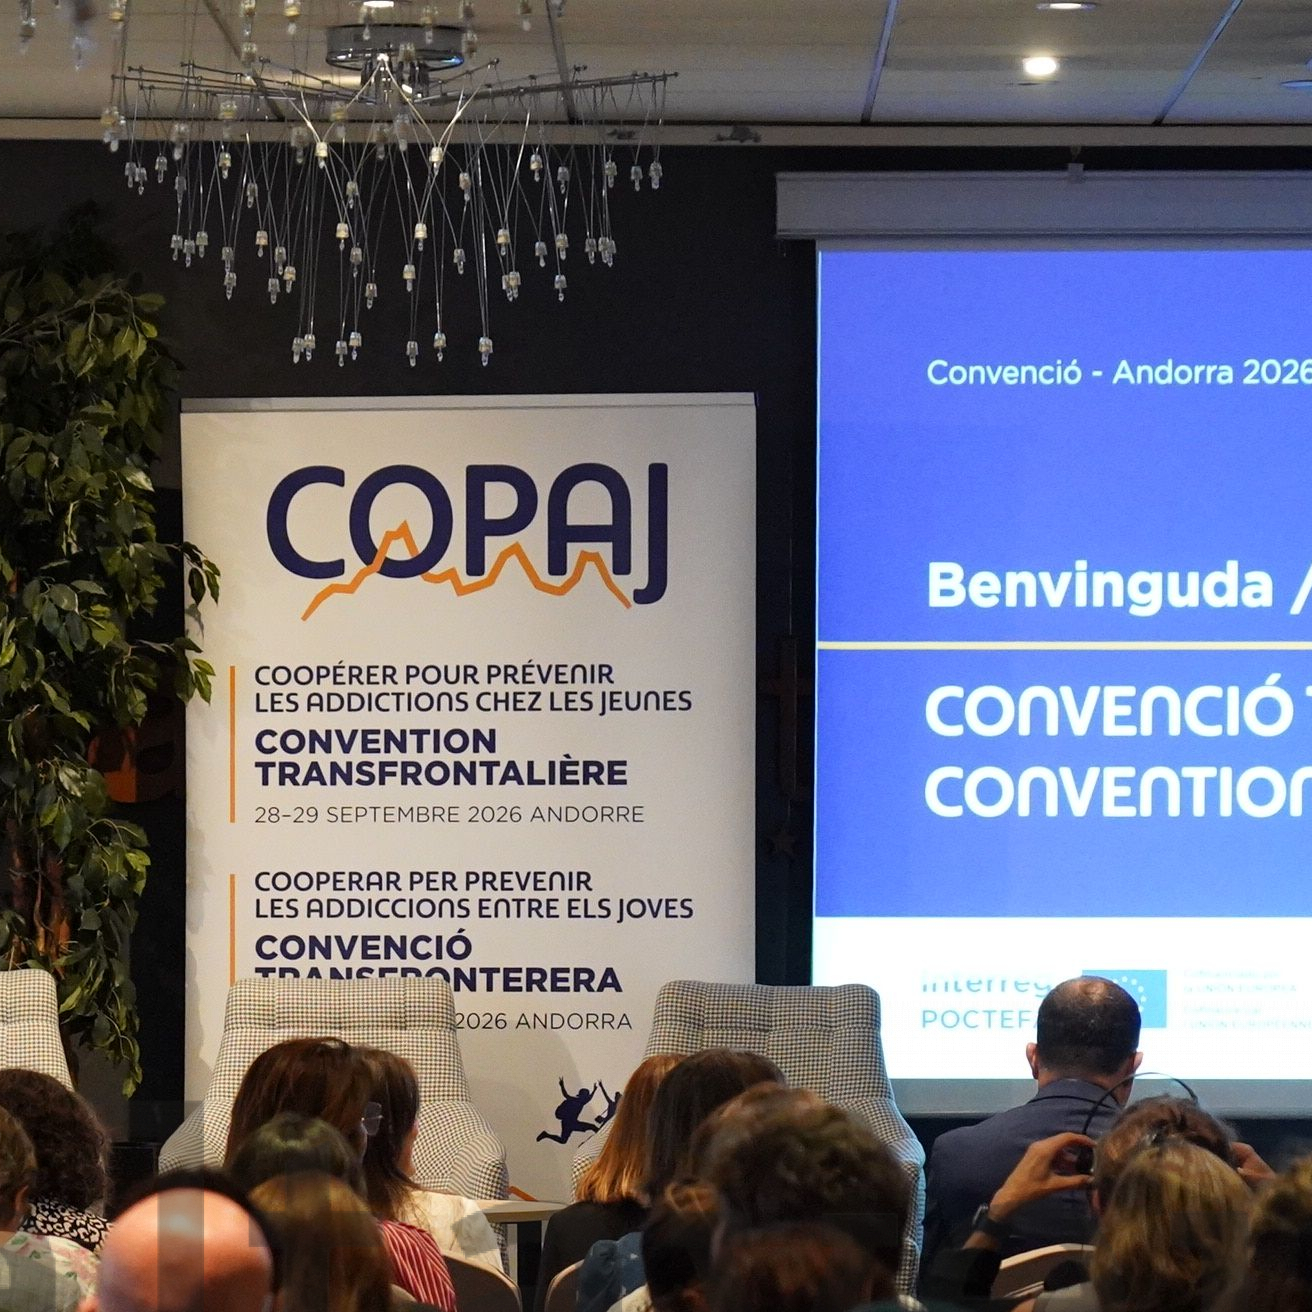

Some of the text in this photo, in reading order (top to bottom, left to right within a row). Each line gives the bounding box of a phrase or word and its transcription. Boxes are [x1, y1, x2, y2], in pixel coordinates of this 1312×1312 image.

[927, 358, 1082, 386] Convenció
[1111, 358, 1234, 385] Andorra
[266, 462, 668, 604] COPAJ
[928, 559, 1274, 617] Benvinguda
[254, 658, 615, 686] COOPÉRER POUR PRÉVENIR
[255, 690, 693, 717] LES ADDICTIONS CHEZ LES JEUNES
[925, 672, 1294, 738] CONVENCIÓ
[254, 728, 497, 755] CONVENTION
[254, 753, 628, 787] TRANSFRONTALIÈRE
[326, 805, 460, 824] SEPTEMBRE
[467, 805, 522, 823] 2026
[529, 805, 645, 823] ANDORRE
[254, 870, 593, 892] COOPERAR PER PREVENIR
[255, 897, 694, 924] LES ADDICCIONS ENTRE ELS JOVES
[255, 929, 472, 960] CONVENCIÓ
[456, 1013, 632, 1030] 2026 ANDORRA
[922, 1009, 1038, 1029] POCTEF
